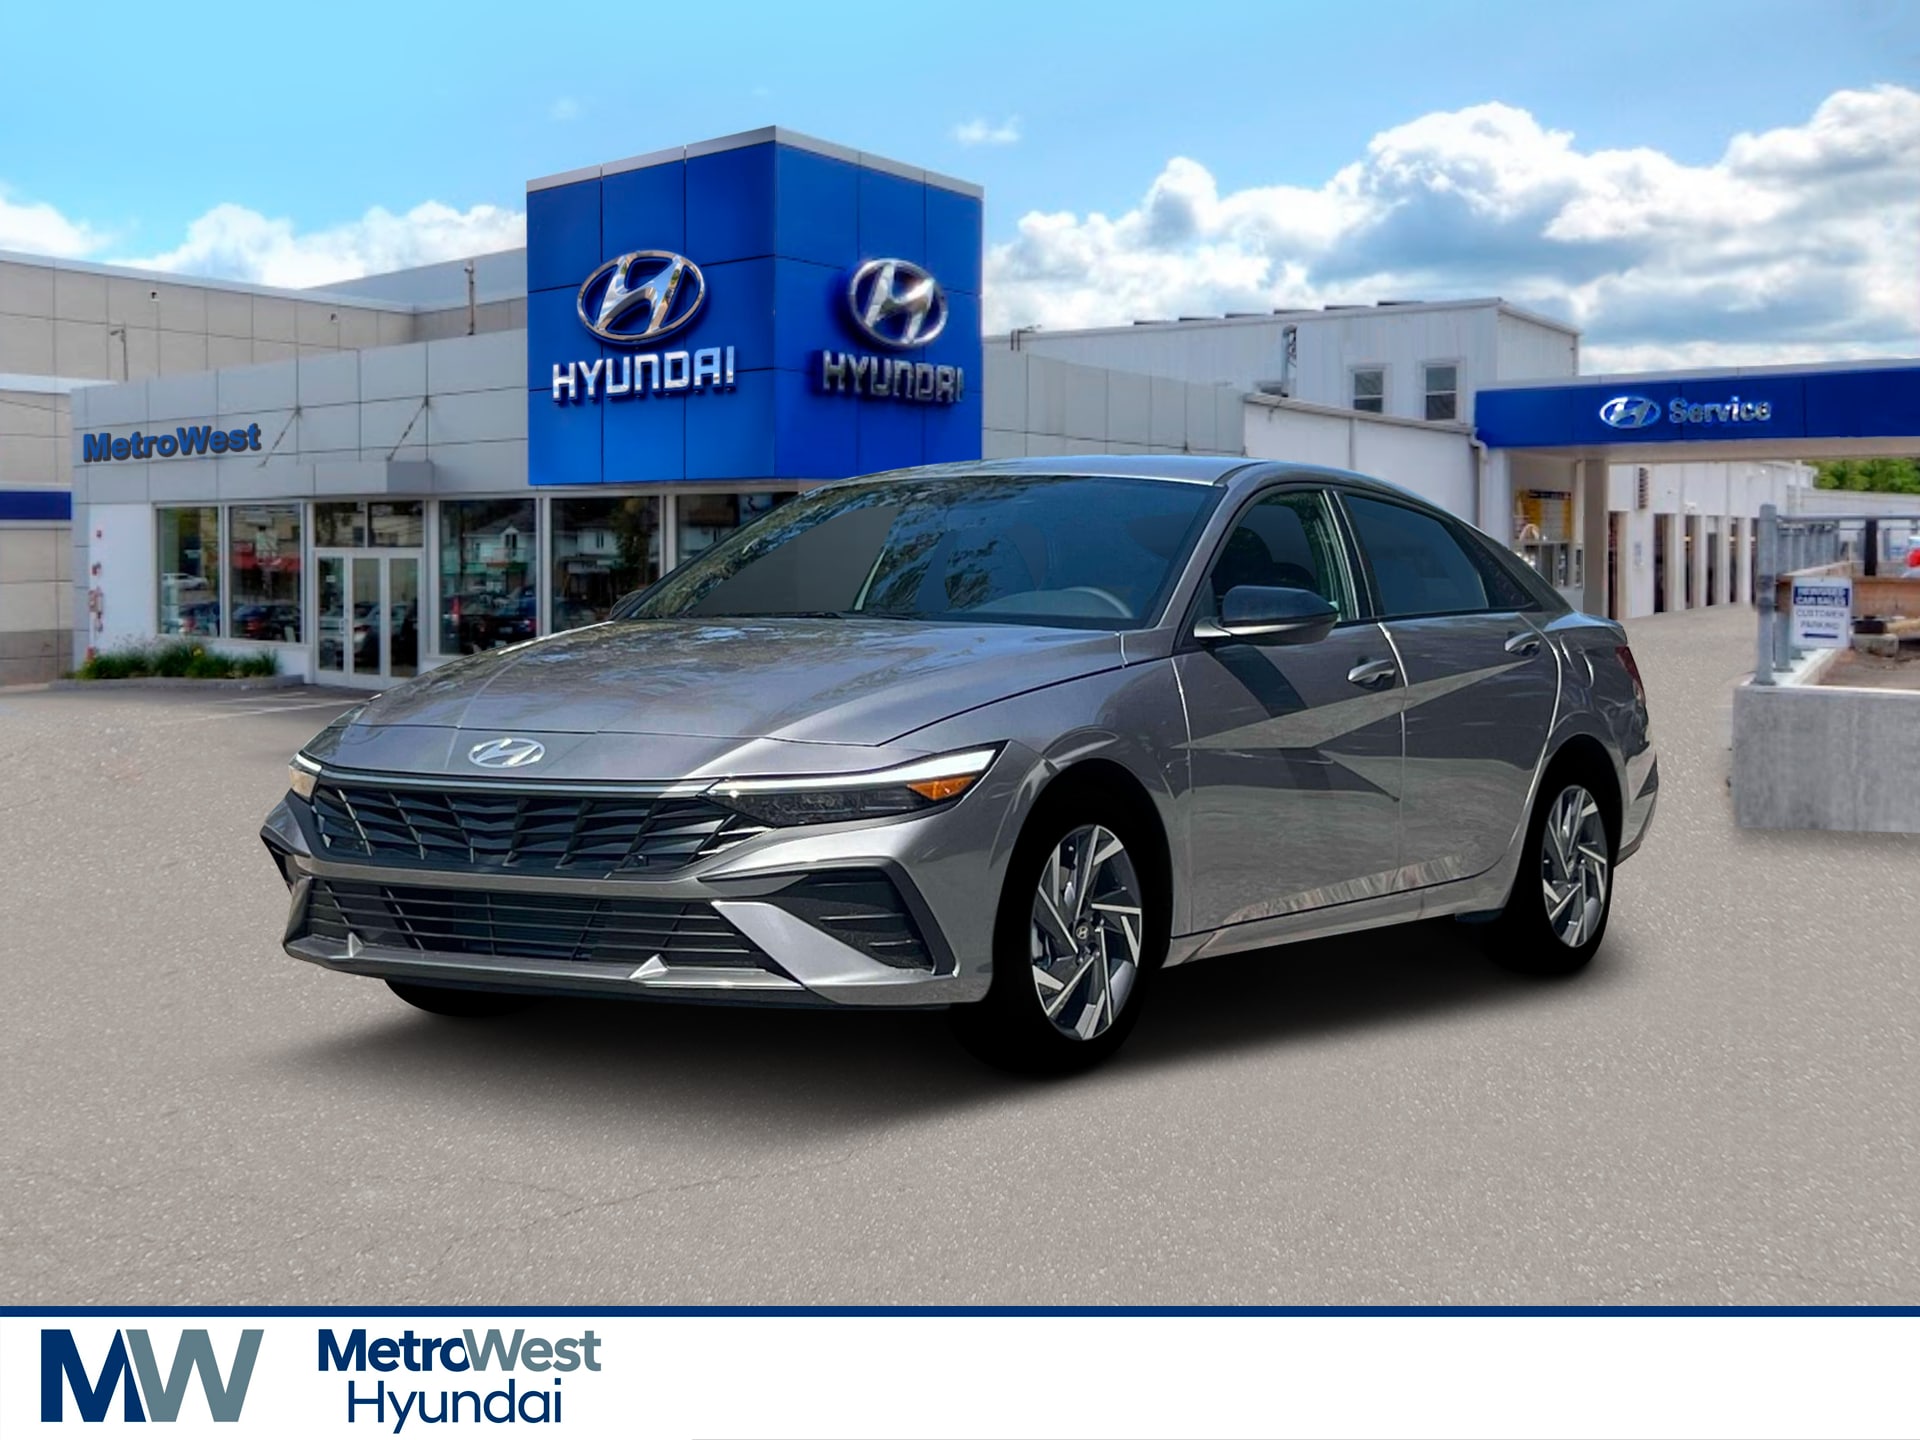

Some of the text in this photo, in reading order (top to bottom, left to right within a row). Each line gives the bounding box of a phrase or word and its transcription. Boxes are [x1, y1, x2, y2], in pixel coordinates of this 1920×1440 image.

[552, 345, 735, 401] HYUNDAI
[823, 350, 963, 403] HYUNDAI
[1669, 396, 1772, 423] Service
[83, 423, 261, 462] MetroWest
